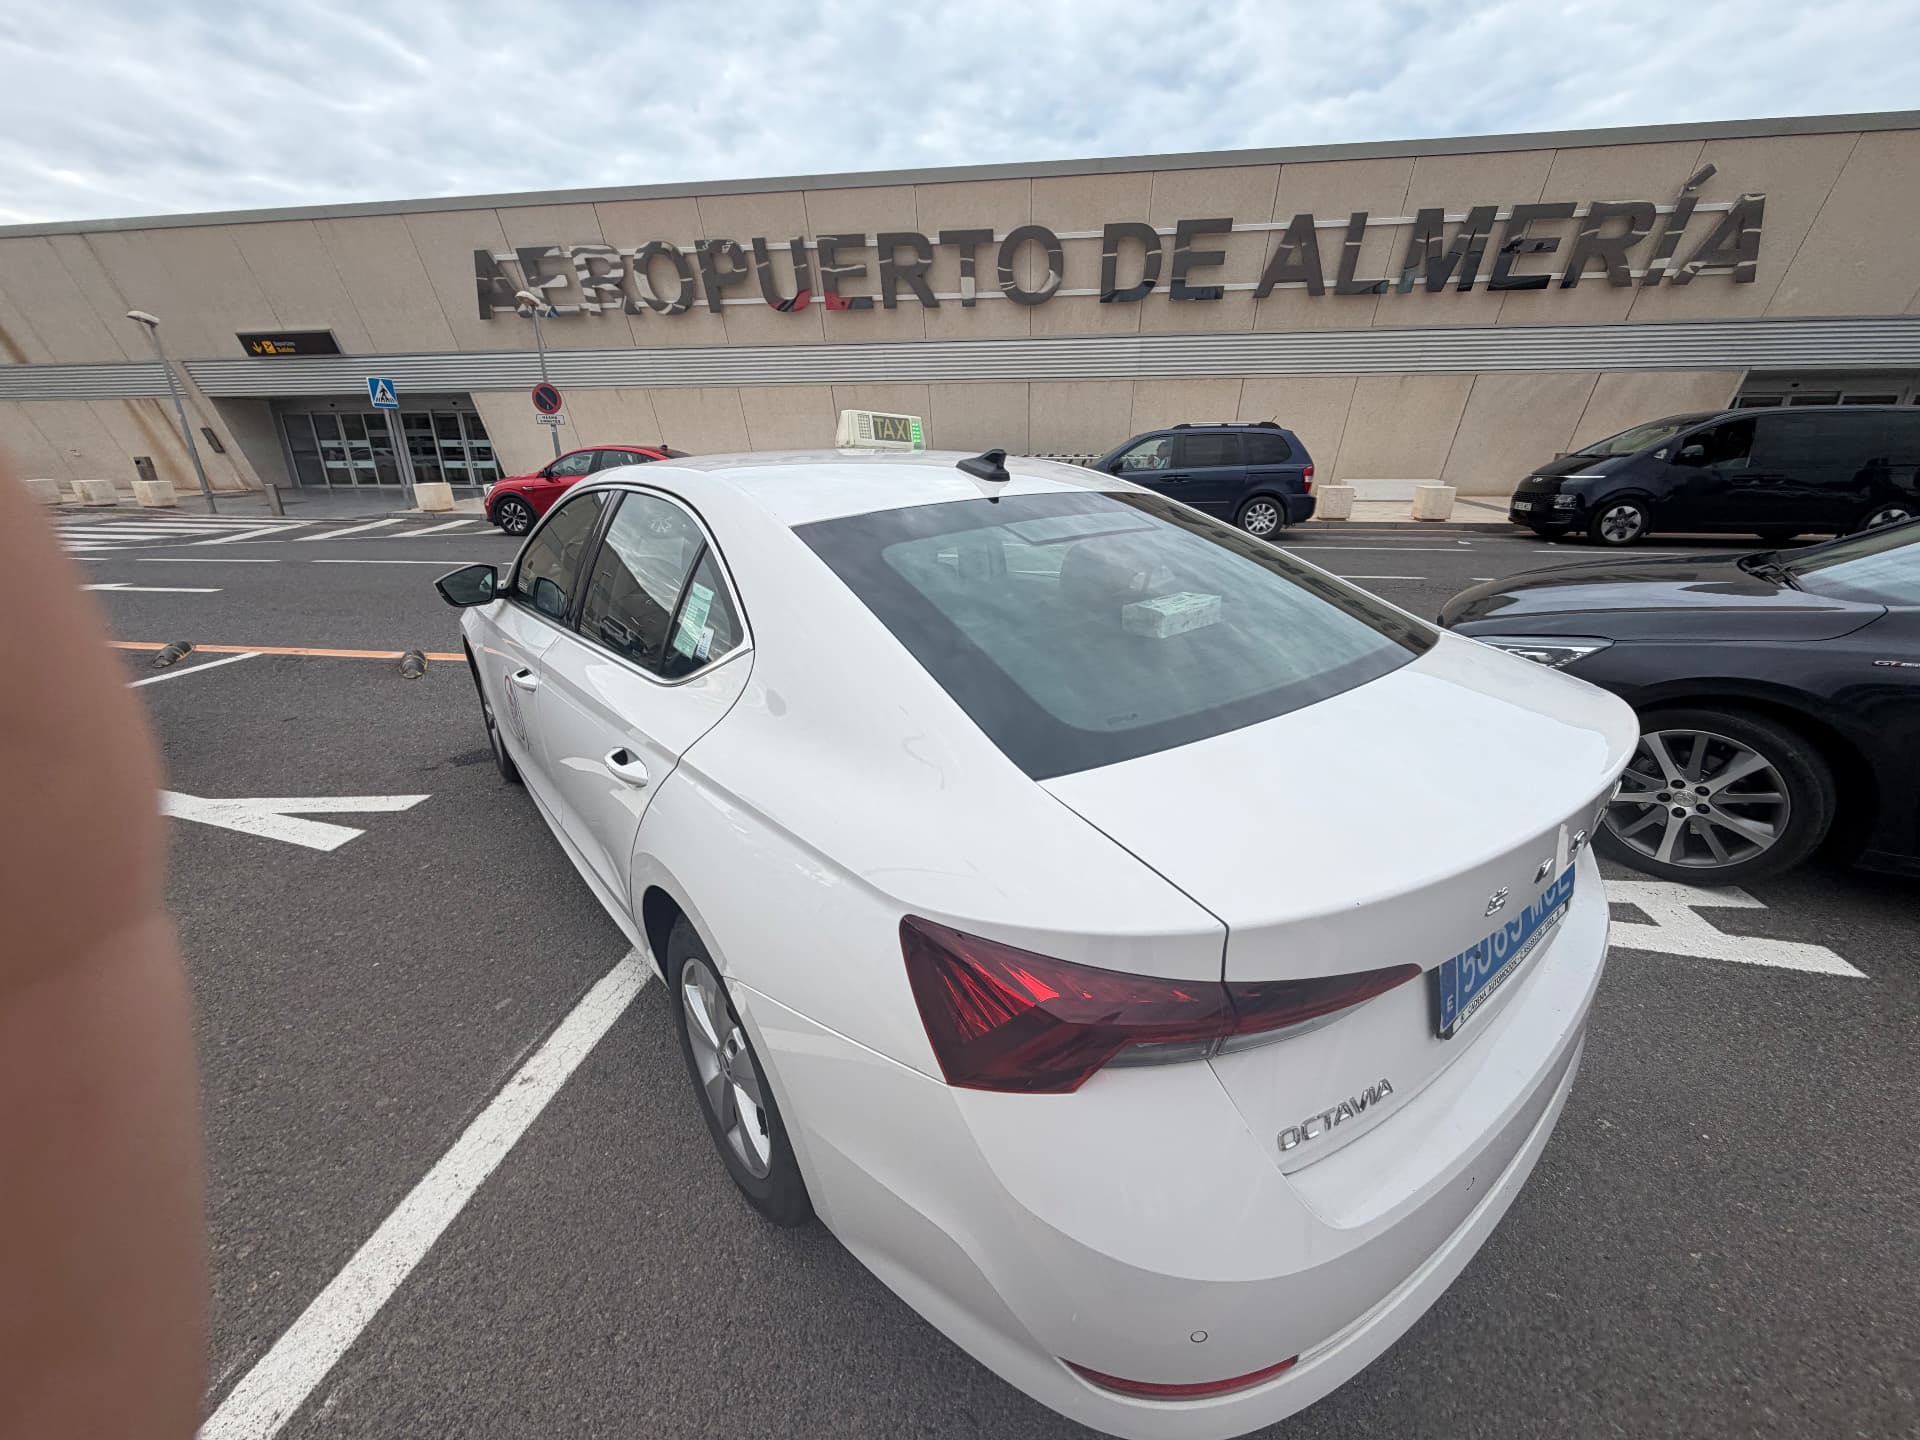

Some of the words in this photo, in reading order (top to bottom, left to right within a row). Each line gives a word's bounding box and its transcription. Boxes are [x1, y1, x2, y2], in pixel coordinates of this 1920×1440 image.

[473, 225, 1064, 320] AEROPUERTO
[1100, 217, 1233, 303] DE
[1254, 163, 1766, 298] ALMERÍA
[873, 418, 911, 440] TAXI
[1447, 993, 1454, 1013] E
[1277, 1078, 1394, 1152] OCTAVIA
